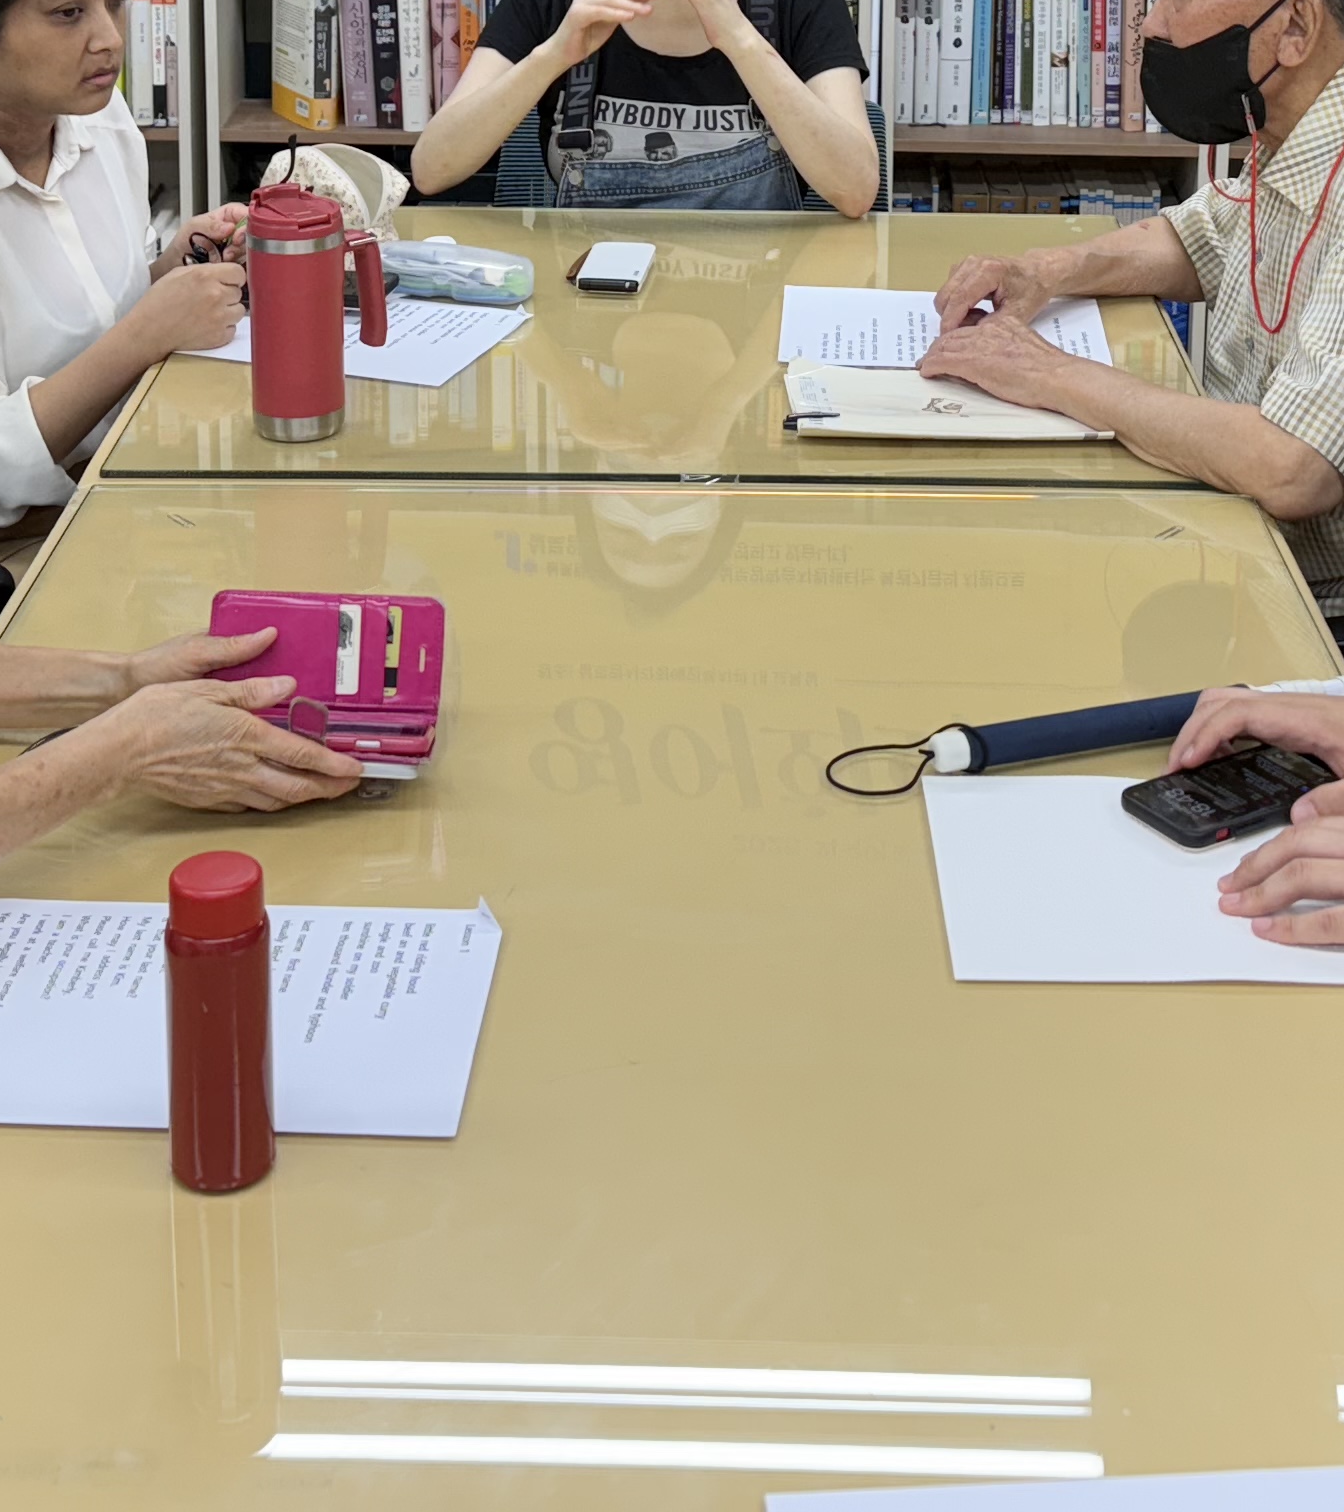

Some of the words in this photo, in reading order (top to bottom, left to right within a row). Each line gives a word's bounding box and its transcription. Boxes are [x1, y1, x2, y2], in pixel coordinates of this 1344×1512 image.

[595, 98, 688, 130] RYBODY
[693, 102, 760, 131] JUSTI
[16, 913, 31, 924] Are
[56, 920, 65, 930] am
[75, 915, 92, 932] What
[94, 916, 112, 935] Please
[118, 916, 132, 931] How
[138, 917, 152, 927] My
[302, 920, 314, 932] last
[8, 927, 22, 939] you
[32, 919, 46, 935] work
[273, 920, 293, 943] visually
[342, 921, 353, 932] ten
[403, 923, 415, 937] beef
[107, 934, 123, 947] may
[132, 930, 144, 940] last
[356, 922, 373, 949] sunshine
[461, 924, 475, 946] Lesson
[61, 943, 76, 957] your
[87, 938, 99, 949] call
[293, 934, 307, 952] name
[330, 935, 349, 965] thousand
[419, 940, 429, 951] red
[36, 940, 59, 965] teacher.
[81, 952, 91, 963] me
[123, 944, 136, 961] name
[144, 944, 157, 959] your
[352, 952, 362, 961] on
[374, 946, 385, 958] and
[394, 951, 405, 964] and
[9, 954, 28, 977] welfare
[92, 955, 112, 980] address
[138, 961, 151, 973] last
[286, 959, 300, 972] first
[346, 964, 358, 975] my
[370, 961, 381, 974] zoo
[410, 954, 426, 973] riding
[40, 960, 66, 1000] occupation?
[110, 973, 126, 987] Kim.
[126, 976, 144, 999] name?
[279, 974, 293, 992] name
[321, 968, 340, 994] thunder
[382, 967, 401, 999] vegetable
[406, 976, 421, 994] hood
[82, 983, 98, 1000] you?
[340, 977, 355, 1001] soldier
[315, 997, 328, 1010] and
[374, 1002, 389, 1020] curry
[304, 1013, 324, 1044] typhoon
